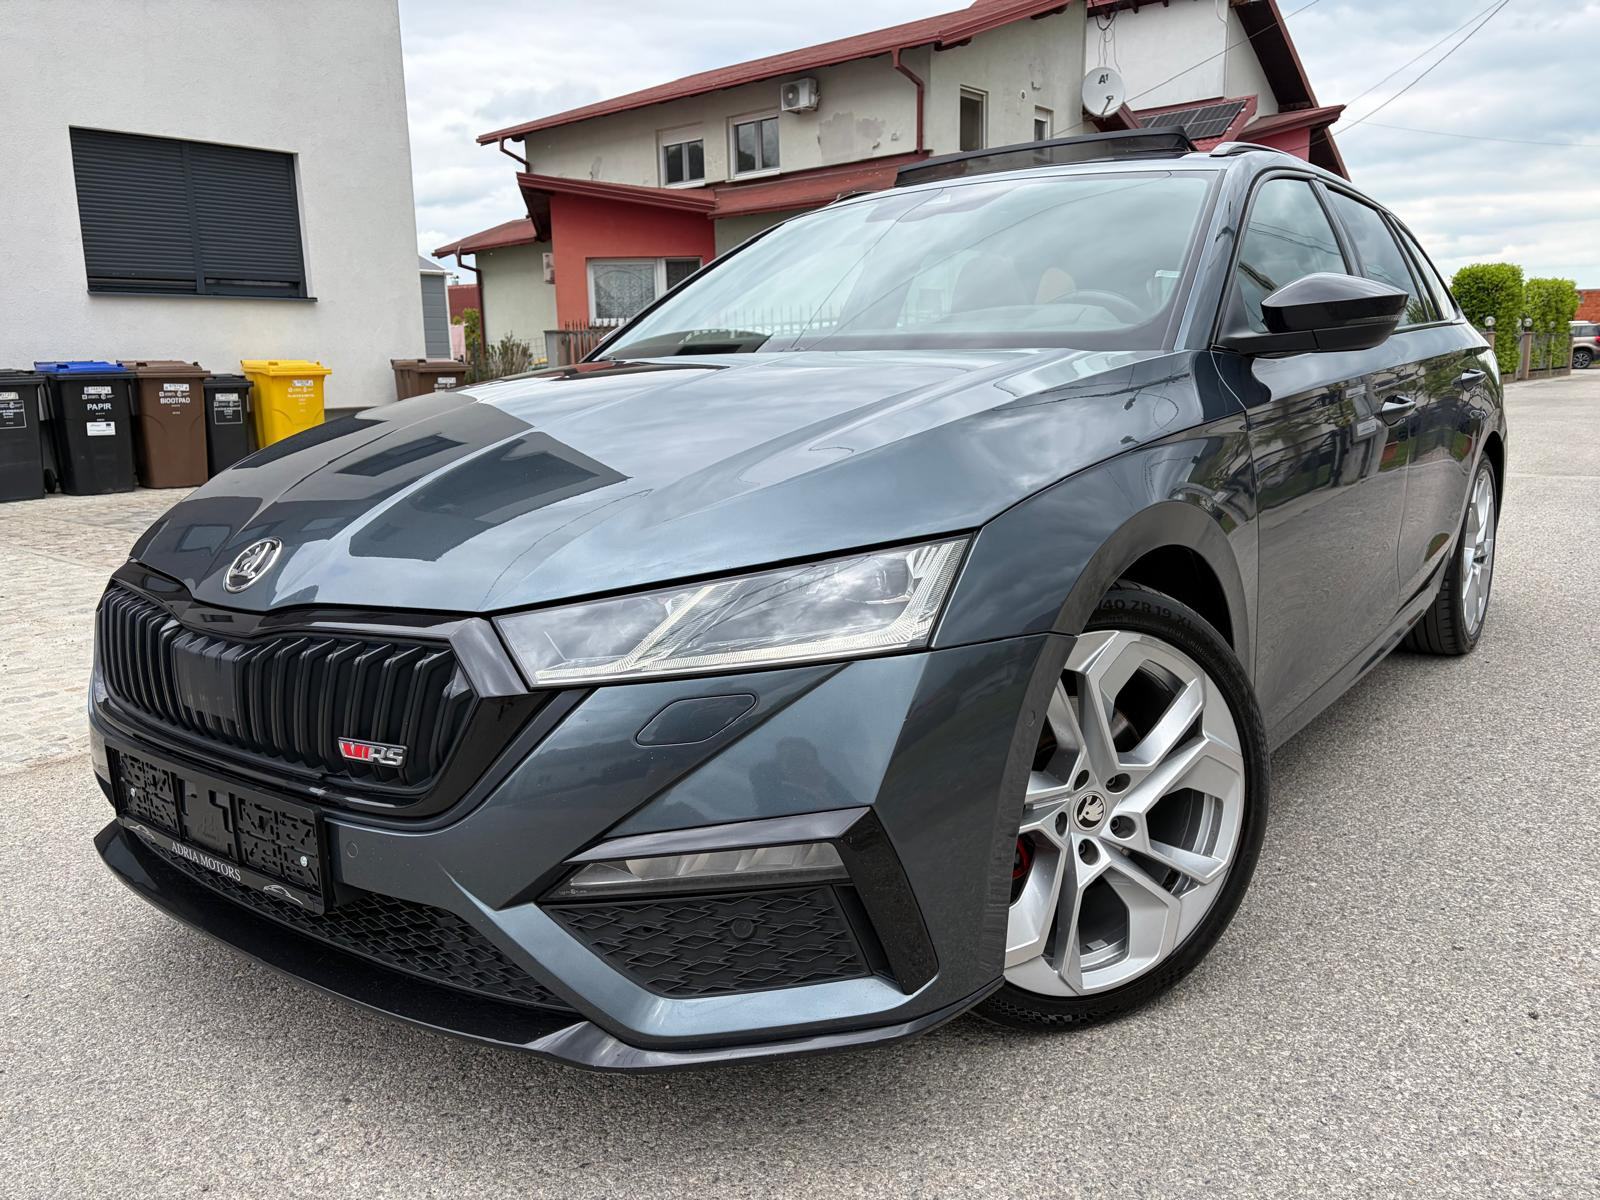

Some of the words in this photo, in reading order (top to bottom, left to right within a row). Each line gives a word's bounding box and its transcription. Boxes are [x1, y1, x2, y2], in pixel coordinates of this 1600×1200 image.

[1098, 73, 1109, 85] A1
[87, 402, 112, 411] PAPIR
[160, 397, 191, 405] BIOOTPAD
[1156, 605, 1172, 619] 19
[171, 841, 199, 863] ADRIA
[200, 853, 241, 882] MOTORS
